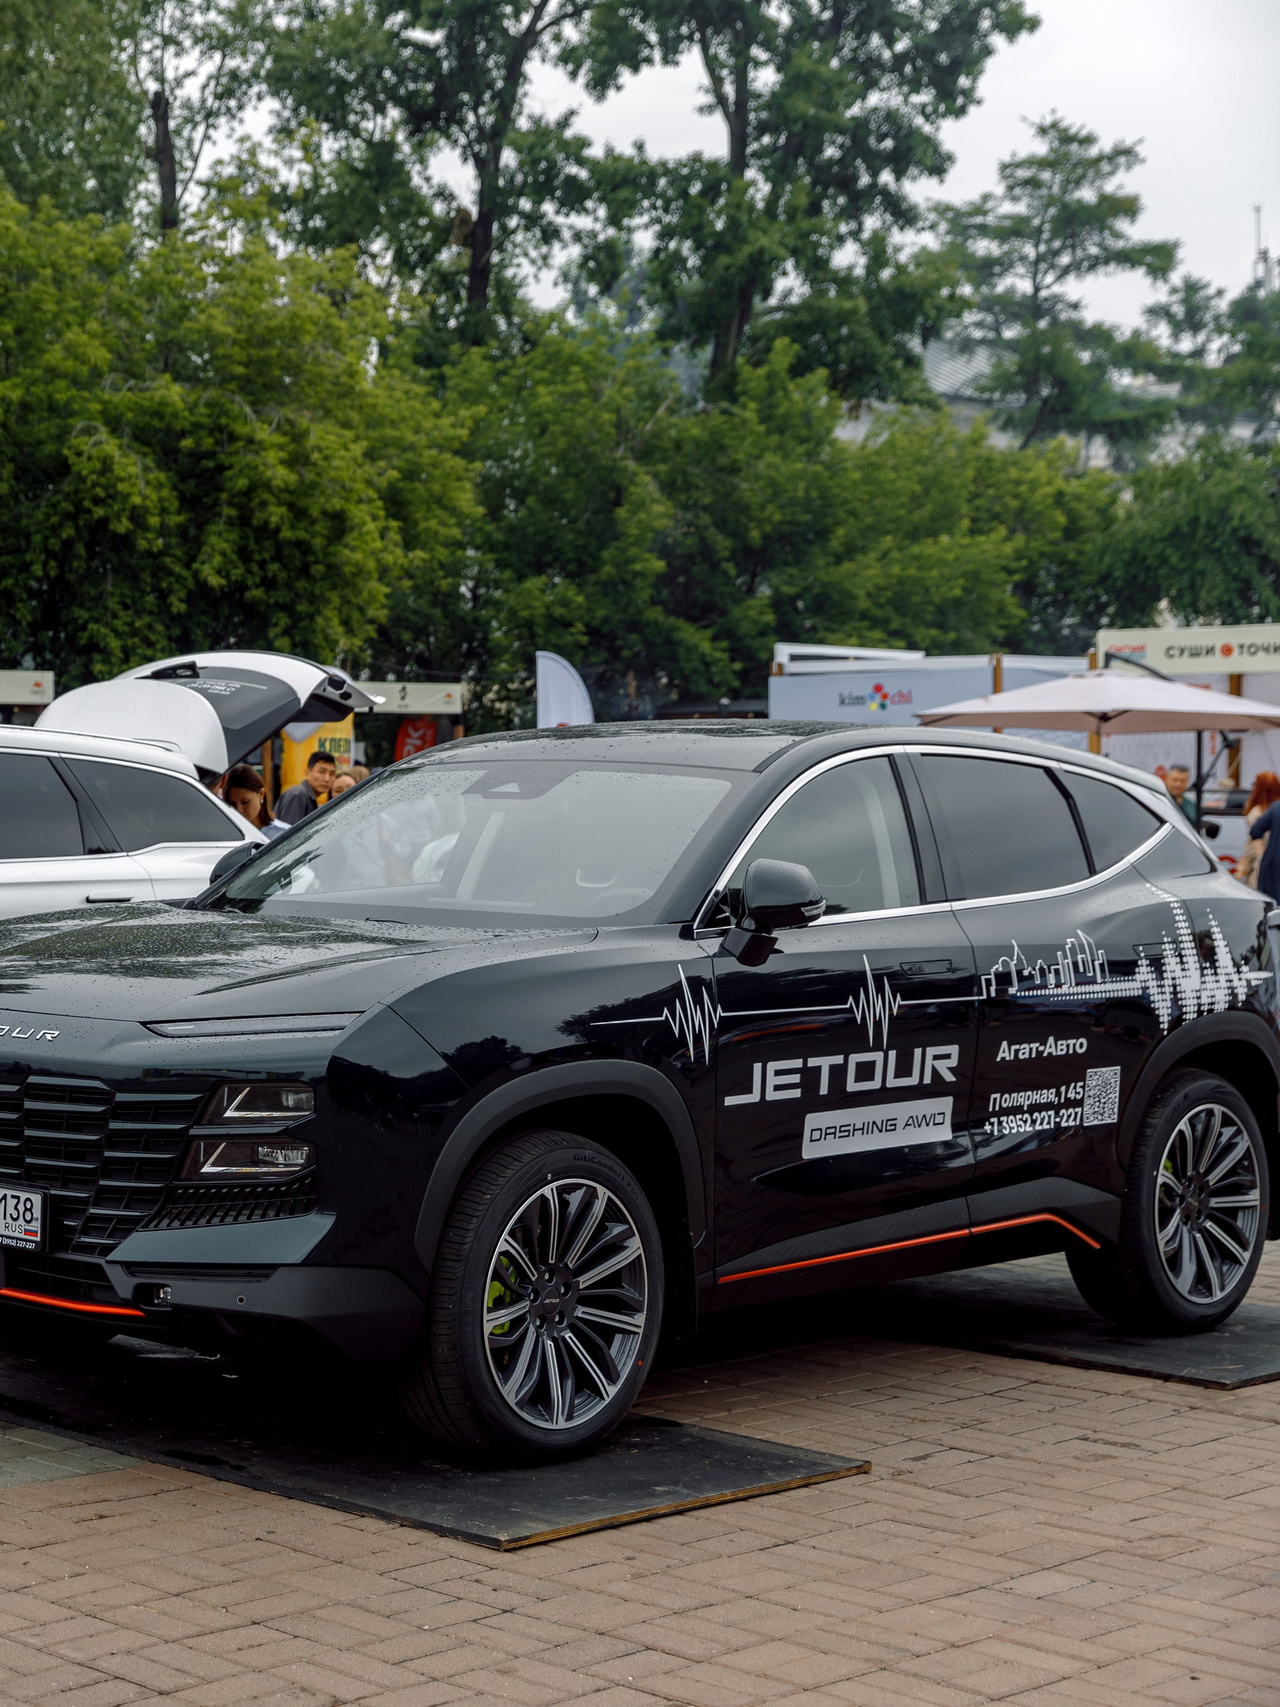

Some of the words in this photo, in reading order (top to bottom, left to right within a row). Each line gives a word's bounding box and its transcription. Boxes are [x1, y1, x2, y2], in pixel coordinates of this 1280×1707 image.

[1164, 643, 1216, 659] СУШИ
[995, 1035, 1088, 1061] Агат-Авто
[724, 1044, 960, 1106] JETOUR
[809, 1117, 898, 1143] DASHING
[902, 1111, 946, 1130] AWD
[1032, 1107, 1083, 1131] 227-227
[573, 1153, 626, 1183] GitiComfort
[4, 1221, 23, 1234] RUS
